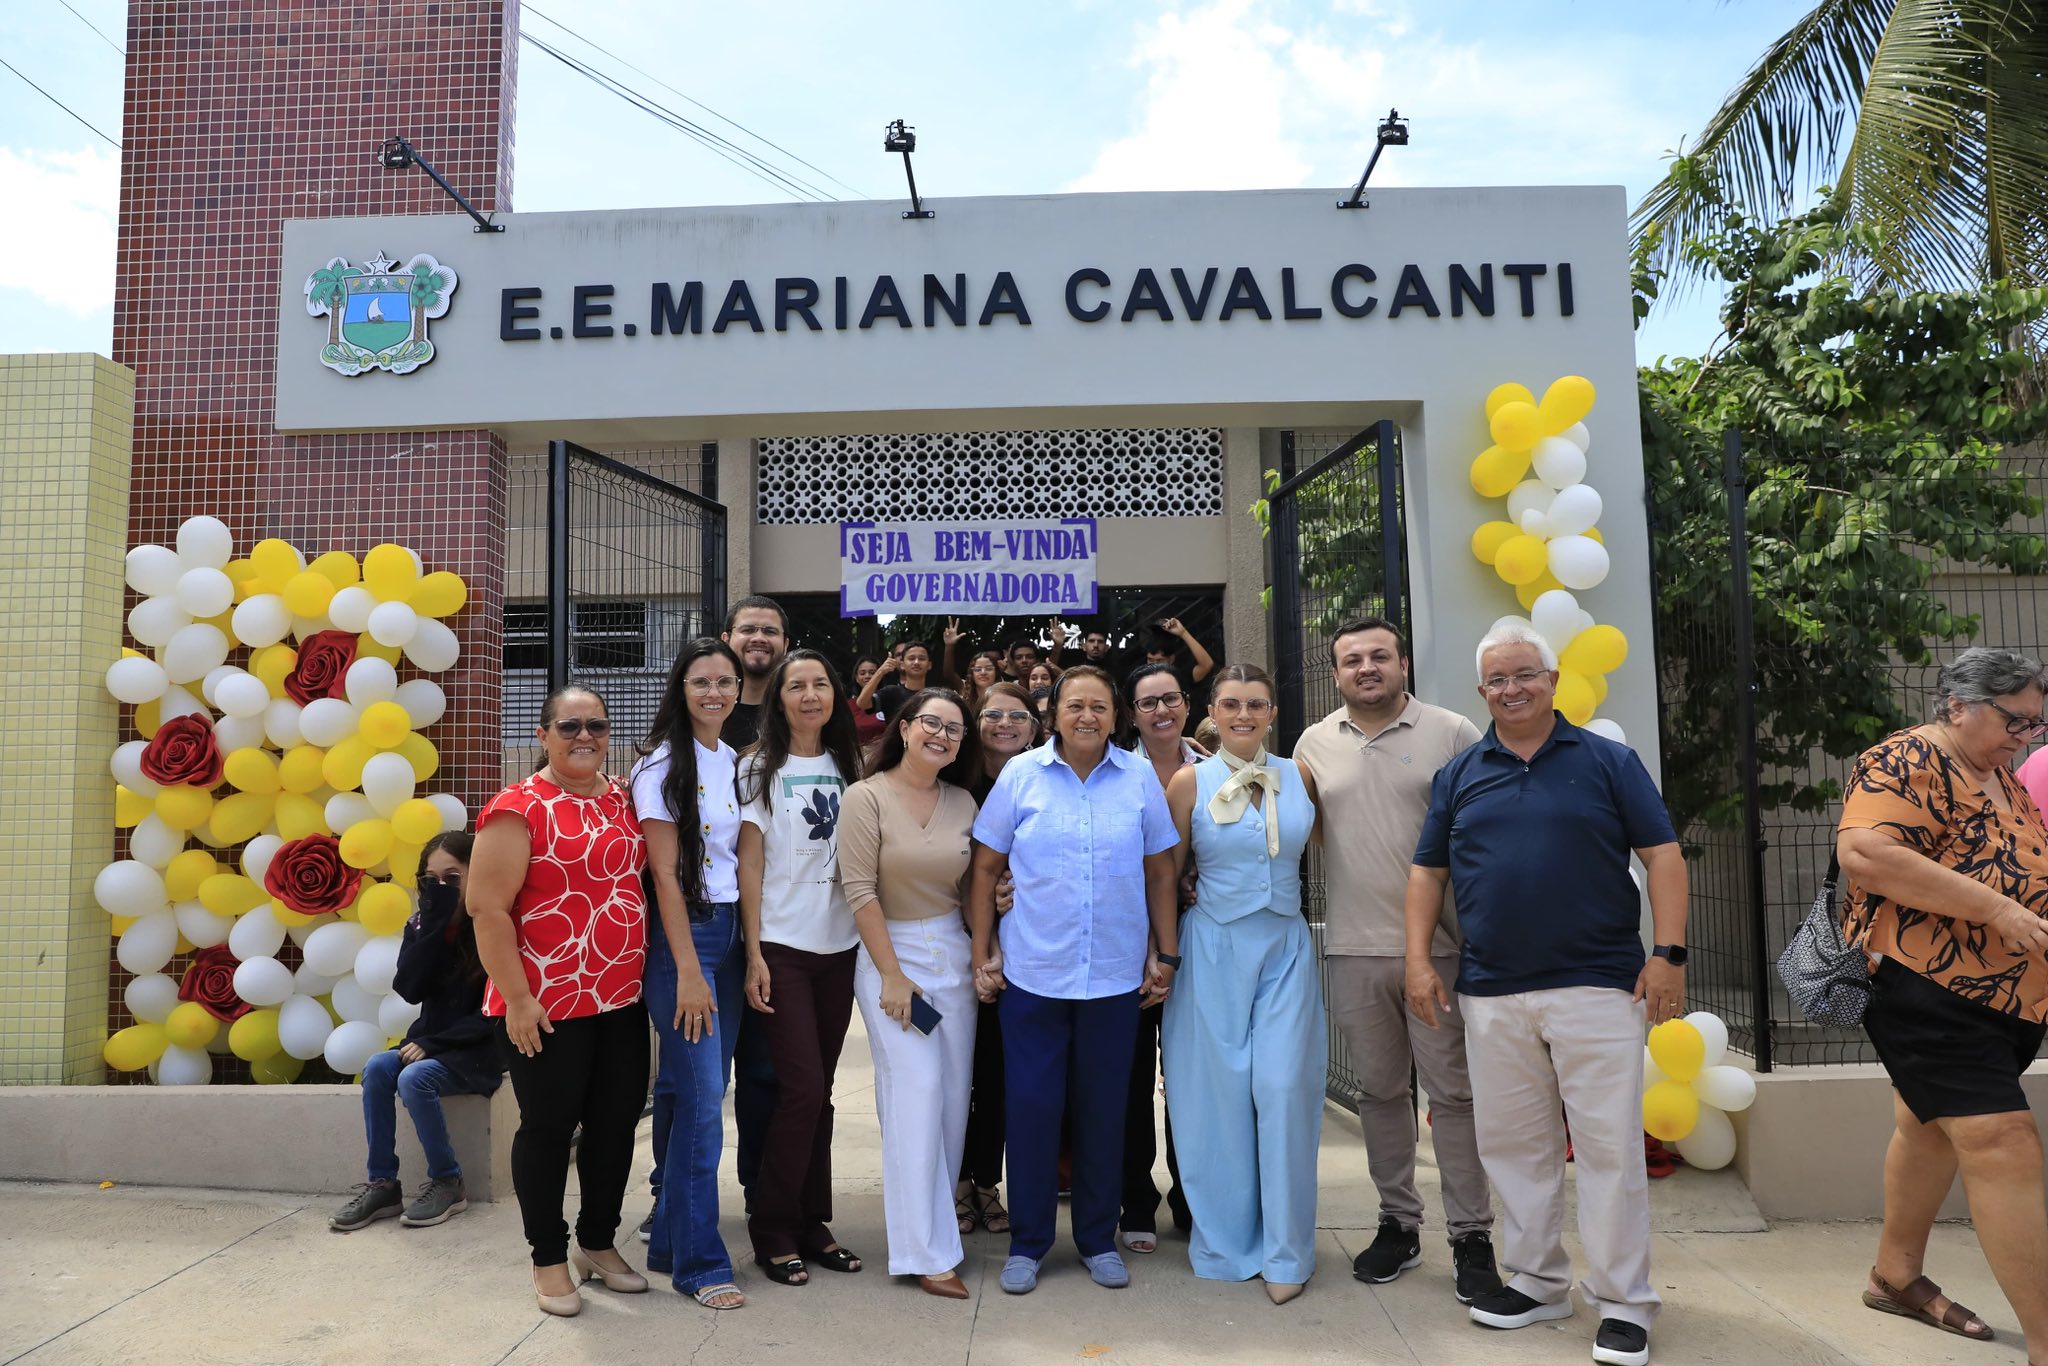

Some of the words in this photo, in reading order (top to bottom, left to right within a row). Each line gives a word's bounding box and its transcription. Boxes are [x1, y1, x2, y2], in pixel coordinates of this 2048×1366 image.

[1065, 263, 1575, 323] CAVALCANTI
[851, 531, 912, 564] SEJA
[935, 529, 1088, 562] BEM-VINDA
[866, 573, 1079, 604] GOVERNADORA
